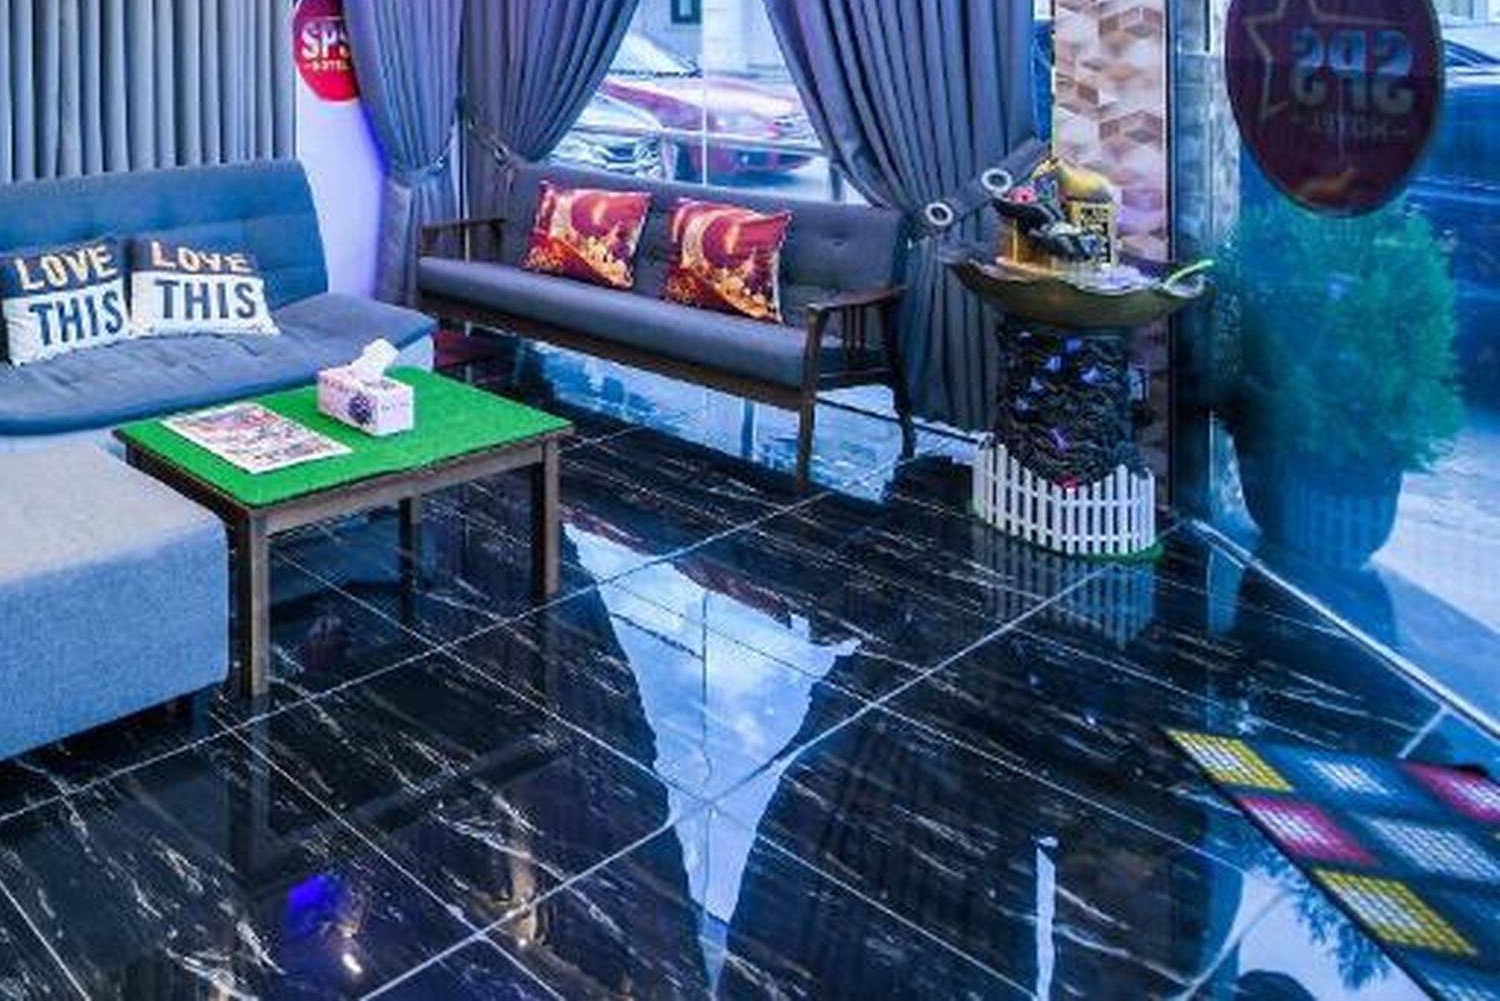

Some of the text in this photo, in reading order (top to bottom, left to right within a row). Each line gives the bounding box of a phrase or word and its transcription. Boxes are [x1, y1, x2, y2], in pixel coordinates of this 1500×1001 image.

[14, 245, 118, 292] LOVE
[151, 241, 252, 273] LOVE
[28, 290, 124, 346] THIS
[154, 279, 256, 320] THIS
